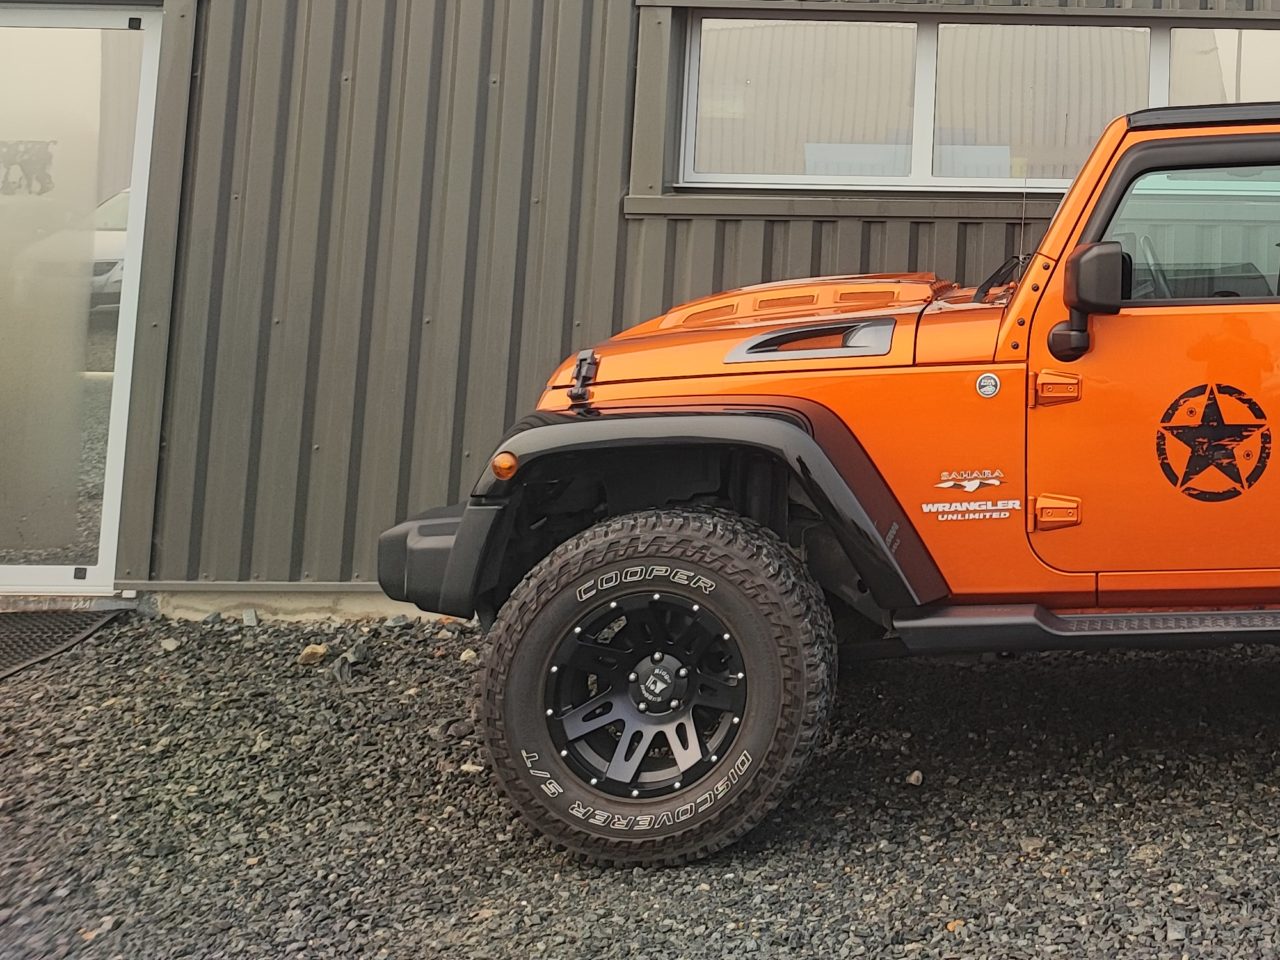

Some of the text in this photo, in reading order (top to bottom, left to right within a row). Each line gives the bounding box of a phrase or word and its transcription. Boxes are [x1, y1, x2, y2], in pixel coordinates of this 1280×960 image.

[940, 470, 1004, 480] SAHARA
[922, 500, 1021, 513] WRANGLER
[938, 512, 1010, 521] UNLIMITED
[576, 565, 716, 602] COOPER
[521, 748, 753, 831] DISCOVERER S/T
